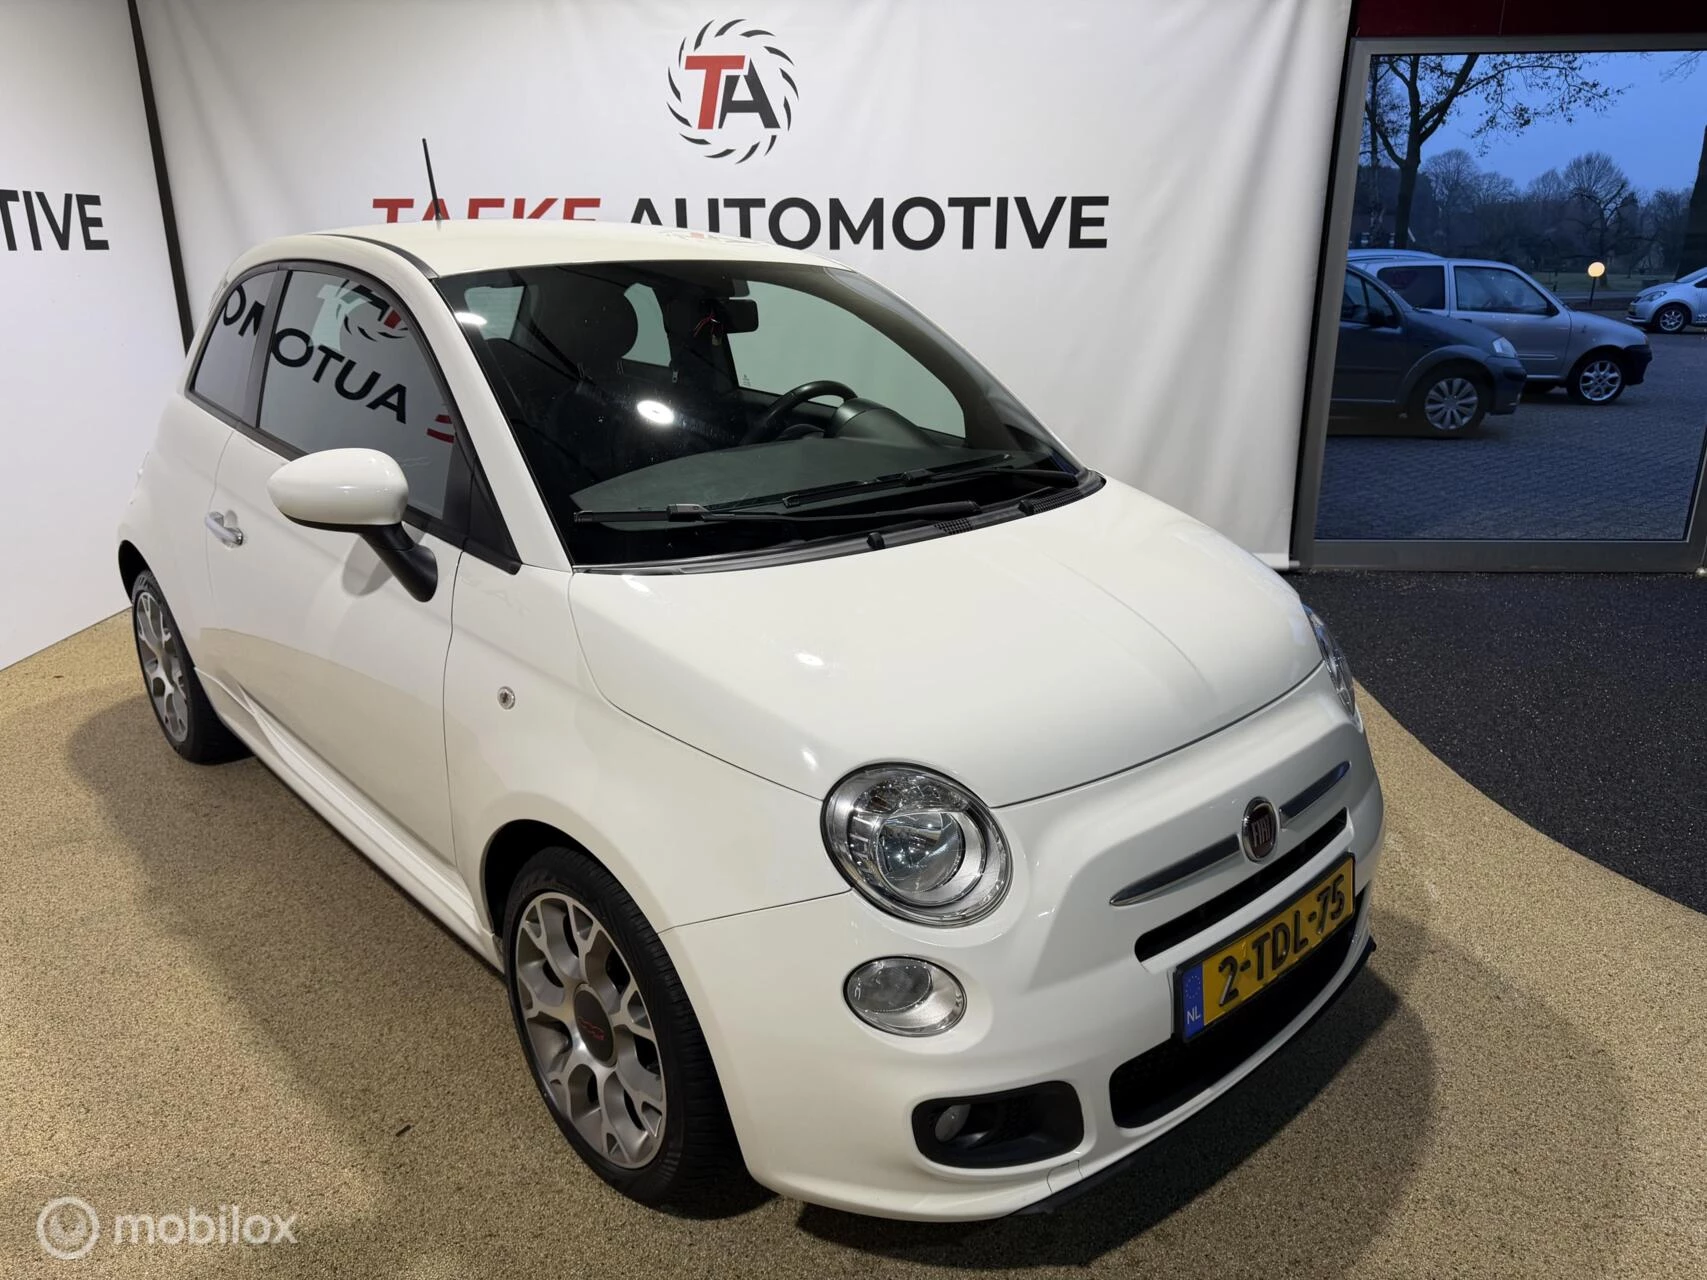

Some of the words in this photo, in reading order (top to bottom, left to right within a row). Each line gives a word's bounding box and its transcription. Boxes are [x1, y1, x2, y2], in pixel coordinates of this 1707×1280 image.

[685, 55, 781, 129] TA
[0, 189, 109, 251] TIVE
[631, 196, 1109, 251] AUTOMOTIVE
[1251, 814, 1273, 848] FIAT
[1218, 873, 1345, 1007] 2-TDL-75
[1186, 1006, 1202, 1025] NL
